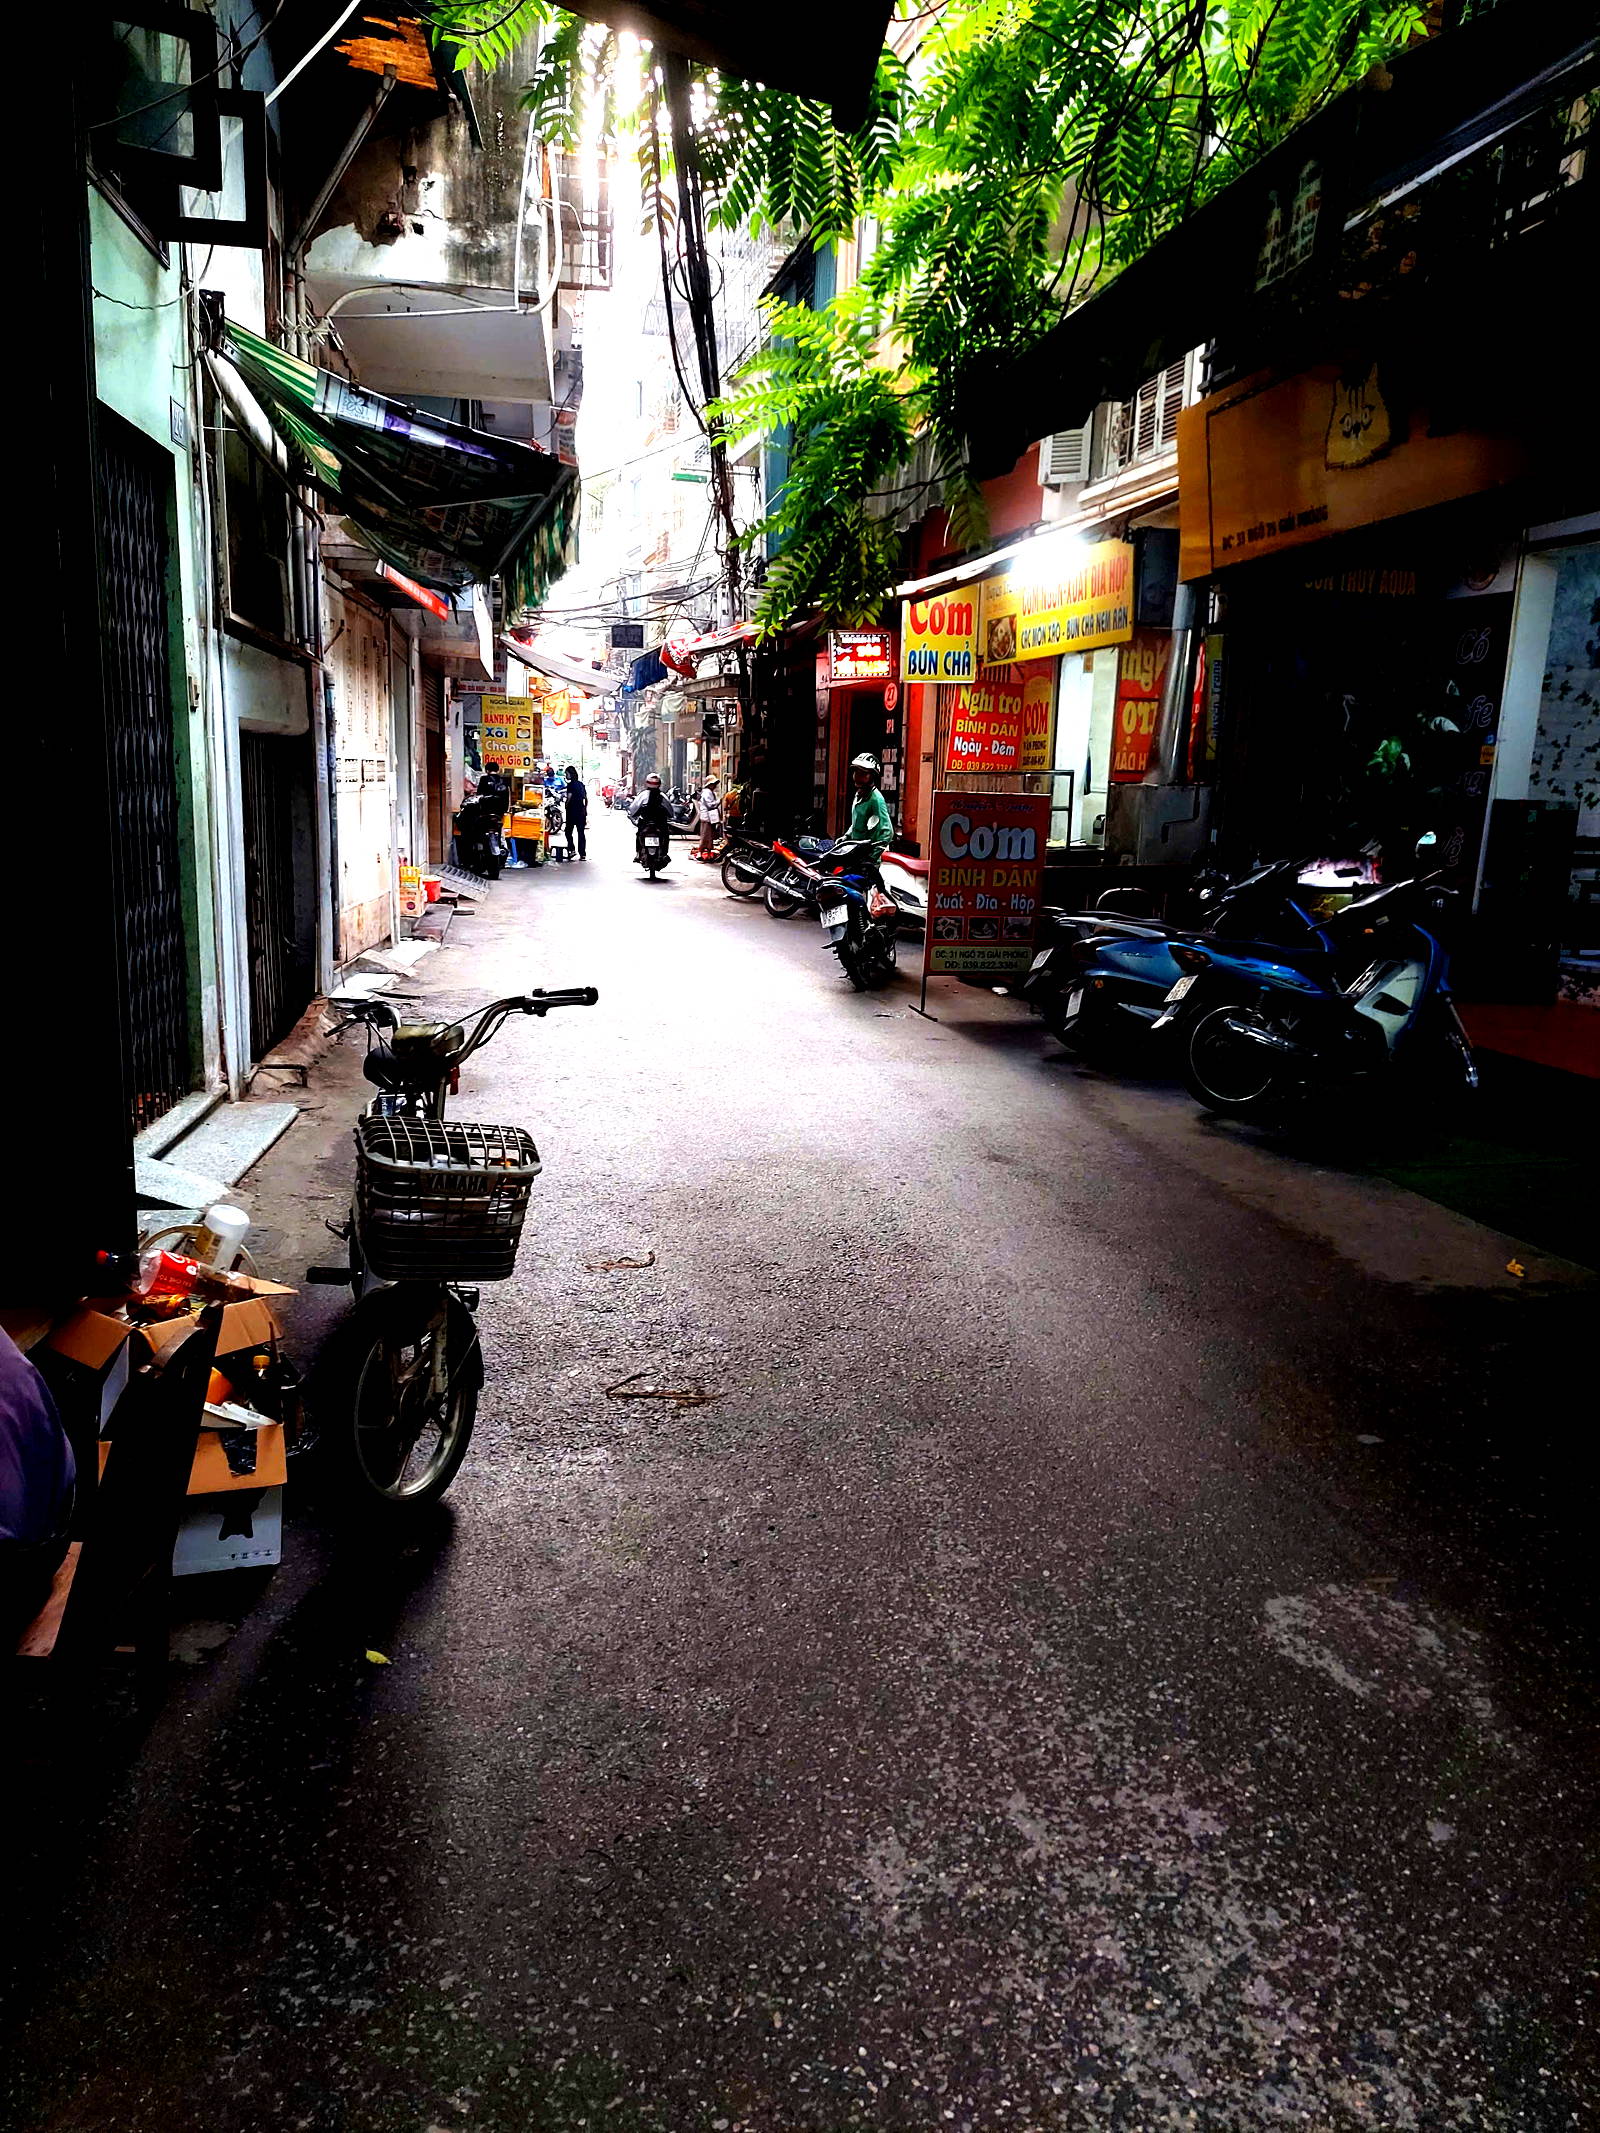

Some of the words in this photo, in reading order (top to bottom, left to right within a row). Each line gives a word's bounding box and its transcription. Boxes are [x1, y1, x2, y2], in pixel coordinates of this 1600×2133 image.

[909, 597, 973, 636] Cơm
[908, 643, 939, 676] BÚN
[944, 641, 971, 676] CHẢ
[999, 692, 1022, 720] trọ
[1023, 700, 1049, 736] CƠM
[485, 727, 508, 739] Xôi
[955, 716, 987, 734] BÌNH
[989, 720, 1019, 737] DÂN
[953, 736, 982, 757] Ngày
[991, 739, 1015, 756] Đêm
[940, 813, 1037, 861] Cơm
[938, 864, 986, 888] BÌNH
[992, 864, 1038, 888] DÂN
[935, 890, 965, 910] Xuất
[1011, 893, 1036, 915] Hộp
[427, 1174, 488, 1193] YAMAHA
